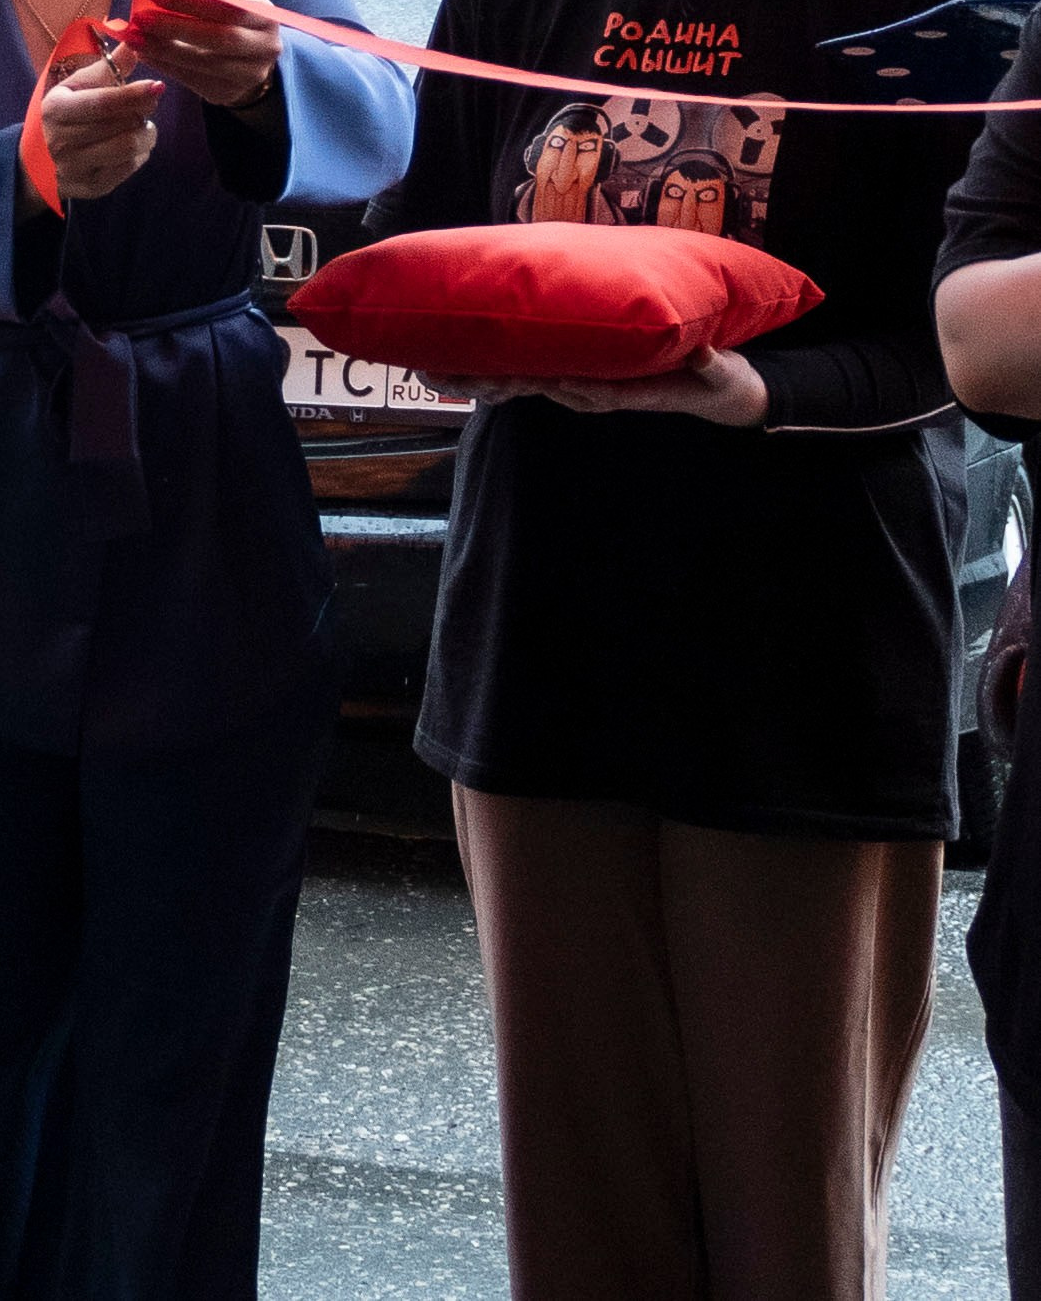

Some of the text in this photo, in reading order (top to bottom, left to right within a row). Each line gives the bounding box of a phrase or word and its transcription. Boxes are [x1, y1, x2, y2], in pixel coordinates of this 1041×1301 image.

[603, 12, 740, 48] РОДИНА
[593, 45, 743, 76] СЛЫШИТ
[392, 385, 436, 402] RUS
[286, 406, 336, 419] NDA
